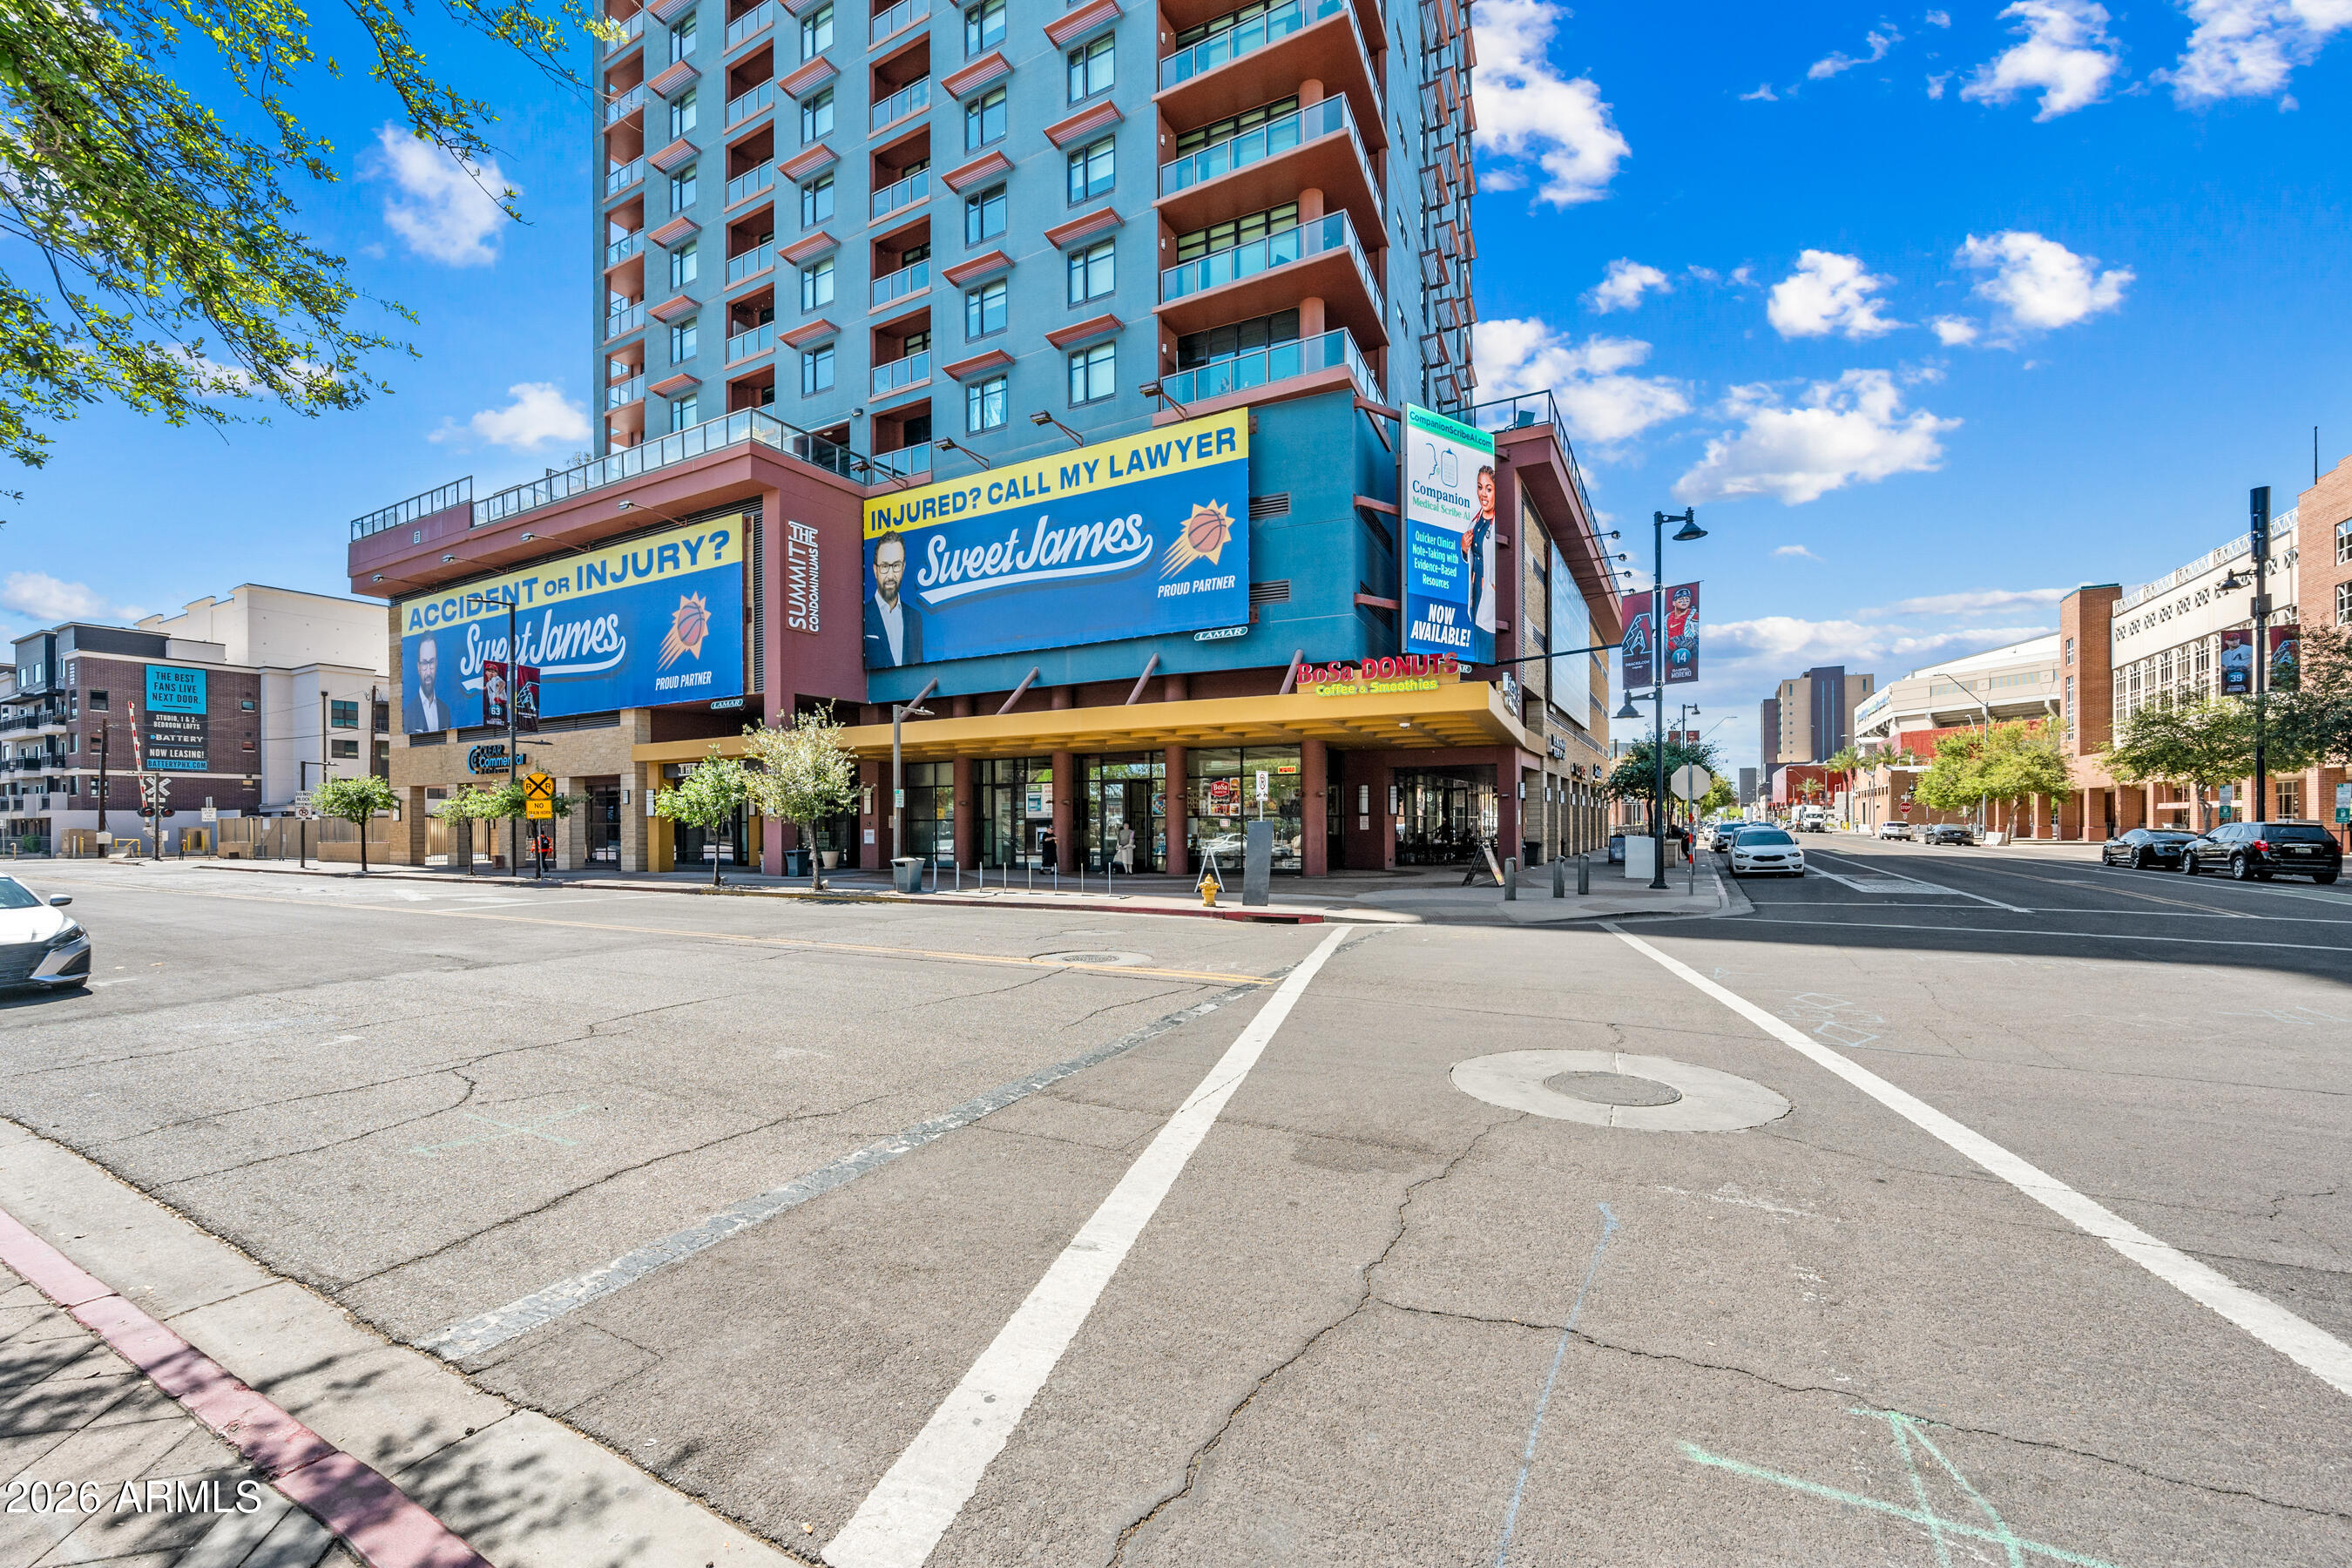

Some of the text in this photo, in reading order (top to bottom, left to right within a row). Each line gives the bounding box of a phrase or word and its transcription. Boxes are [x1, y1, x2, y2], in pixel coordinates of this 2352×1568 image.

[1409, 410, 1492, 449] CompanionScribeAI.com
[871, 426, 1236, 531] INJURED? CALL MY LAWYER
[1412, 480, 1470, 508] Companion
[1412, 497, 1439, 511] Medical
[1441, 504, 1462, 517] Scribe
[787, 521, 819, 548] THE
[1415, 531, 1456, 551] Quicker Clinical
[917, 513, 1144, 586] Sweet James
[1412, 544, 1458, 564] Note-Taking with
[1414, 558, 1457, 577] Evidence-Based
[409, 577, 538, 632] ACCIDENT
[577, 530, 730, 591] INJURY?
[787, 540, 807, 630] SUMMIT
[808, 547, 819, 632] CONDOMINIUMS
[1158, 575, 1235, 598] PROUD PARTNER
[1423, 574, 1450, 589] Resources
[1428, 603, 1456, 625] NOW
[529, 608, 620, 665] James
[1198, 627, 1243, 640] LAMAR
[1410, 620, 1471, 647] AVAILABLE!
[1676, 651, 1687, 663] 14
[156, 671, 195, 683] THE BEST
[1296, 652, 1459, 684] BoSa DONUTS
[154, 682, 197, 693] FANS LIVE
[655, 671, 712, 691] PROUD PARTNER
[1316, 683, 1356, 696] Coffee
[1369, 679, 1438, 693] Smoothies
[152, 693, 201, 704] NEXT DOOR.
[713, 699, 741, 709] LAMAR
[490, 706, 501, 715] 63
[156, 734, 204, 743] BATTERY
[150, 748, 205, 759] NOW LEASING!
[479, 753, 524, 767] Commeral
[148, 760, 206, 769] BATTERYPHX.COM
